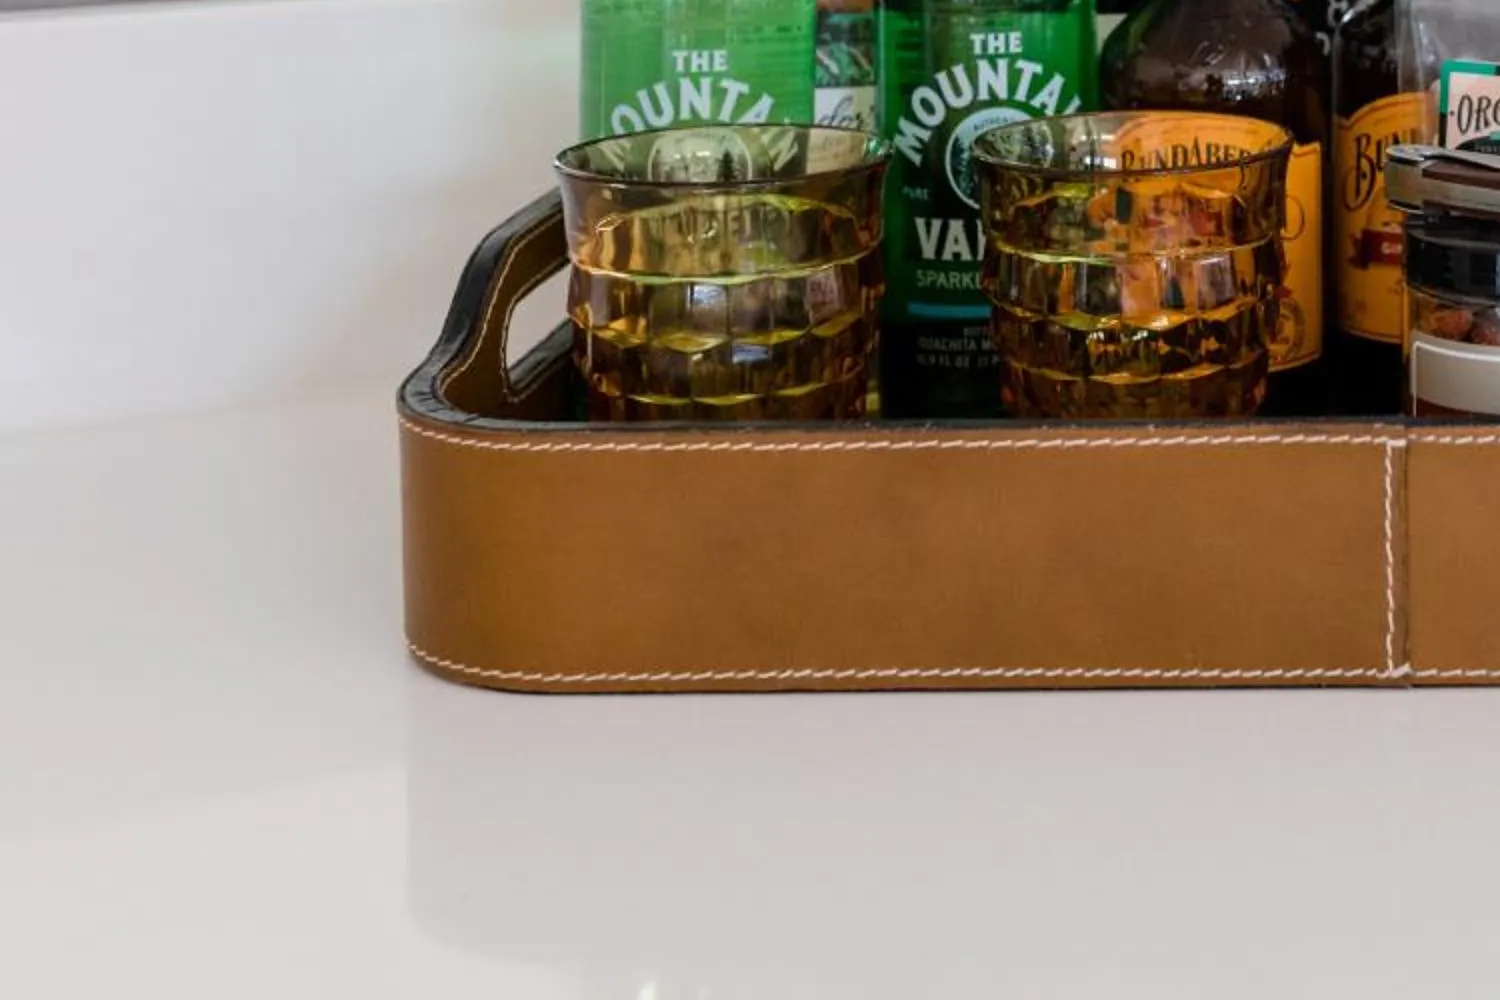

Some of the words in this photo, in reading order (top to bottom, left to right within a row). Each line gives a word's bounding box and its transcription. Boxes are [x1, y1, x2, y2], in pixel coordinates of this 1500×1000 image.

[968, 31, 1023, 55] THE
[672, 49, 728, 73] THE
[893, 58, 1082, 168] MOUNTA
[913, 216, 987, 261] VA
